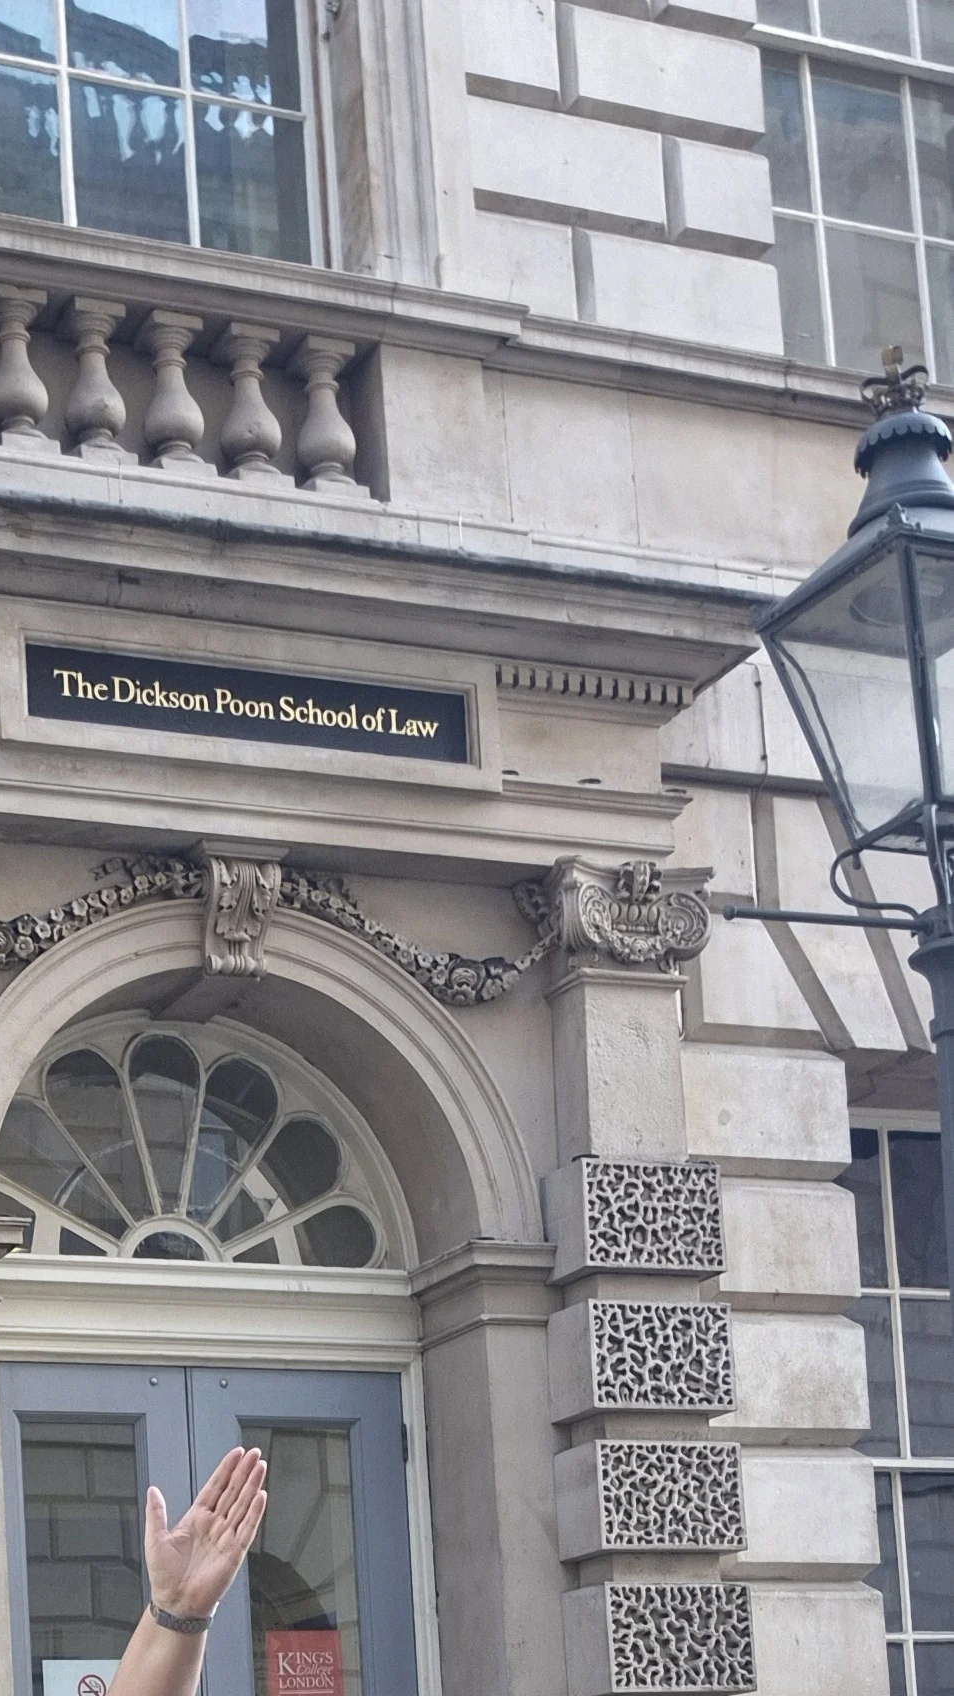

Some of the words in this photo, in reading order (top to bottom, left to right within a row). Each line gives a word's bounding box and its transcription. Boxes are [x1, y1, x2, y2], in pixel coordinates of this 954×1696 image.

[53, 668, 109, 702] The
[112, 676, 209, 713] Dickson
[214, 688, 275, 721] Poon
[279, 696, 357, 731] School
[361, 707, 386, 733] of
[388, 709, 439, 739] Law
[296, 1664, 334, 1678] College
[279, 1676, 334, 1689] LONDON
